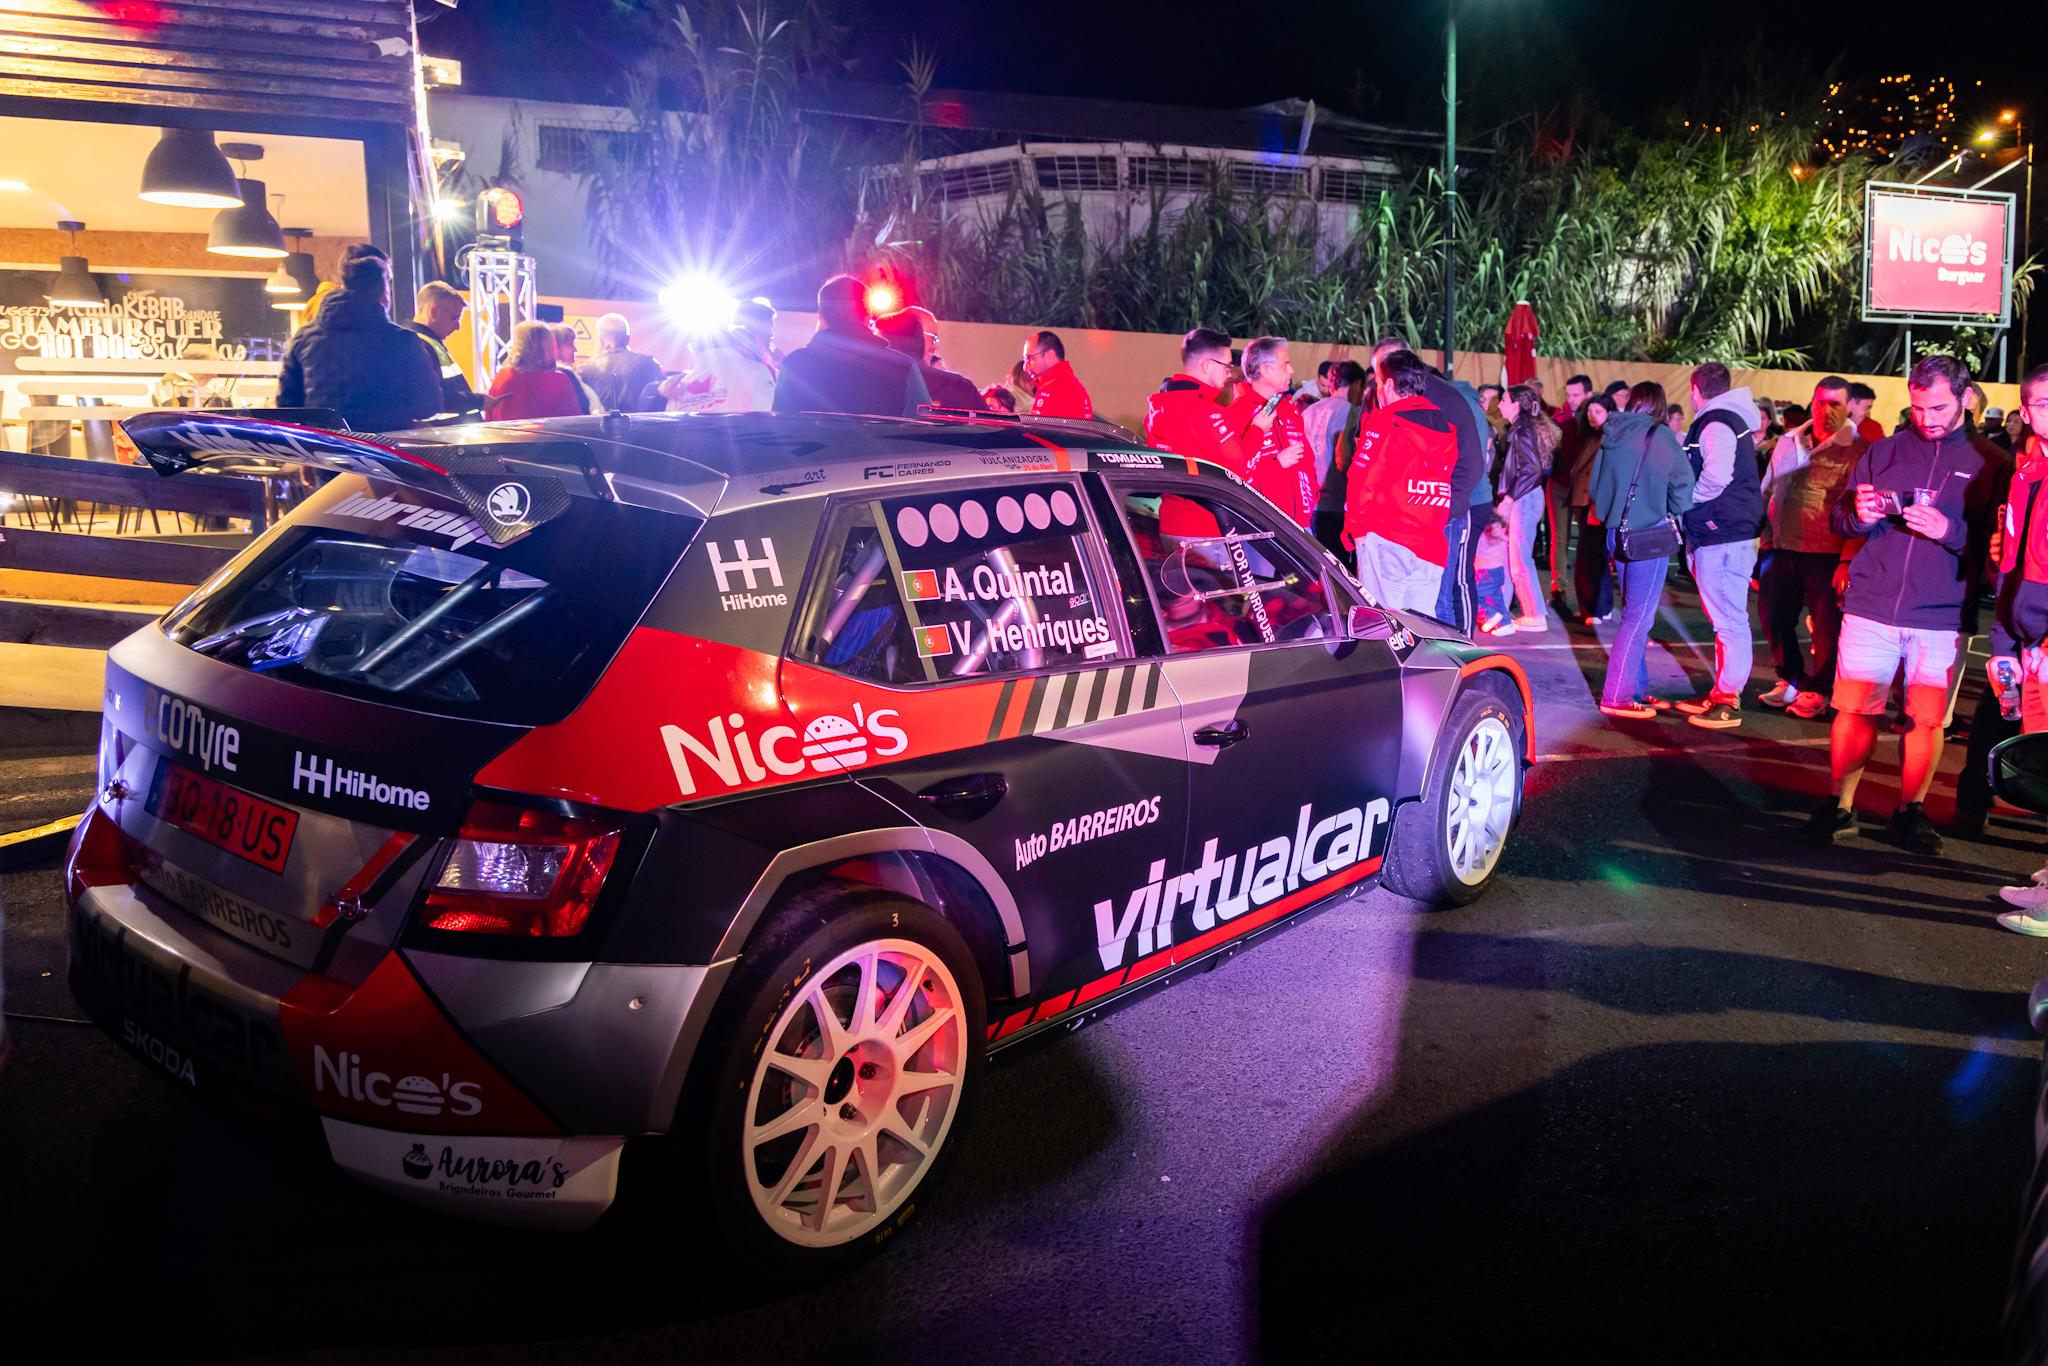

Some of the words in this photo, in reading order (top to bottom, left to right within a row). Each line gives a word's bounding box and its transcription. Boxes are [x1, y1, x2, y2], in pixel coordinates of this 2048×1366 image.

[123, 296, 184, 320] KEBAB
[12, 316, 223, 339] HAMBURGUER
[40, 333, 84, 358] HOT
[897, 460, 952, 471] FERNANDO
[979, 455, 1050, 465] VULCANIZADORA
[1096, 453, 1162, 464] TOMIAUTO
[898, 467, 936, 477] CAIRES
[1407, 479, 1452, 498] LOTE
[944, 562, 1076, 602] A.Quintal
[720, 591, 788, 612] HiHome
[985, 614, 1110, 654] Henriques
[660, 701, 909, 796] Nico's
[335, 766, 431, 811] HiHome
[1014, 830, 1047, 872] Auto
[1049, 795, 1162, 854] BARREIROS
[1093, 797, 1390, 972] virtualcar
[313, 1044, 483, 1117] Nico's
[437, 1144, 570, 1189] Aurora's
[438, 1180, 502, 1198] Brigadeiros
[505, 1188, 556, 1201] Gourmet
